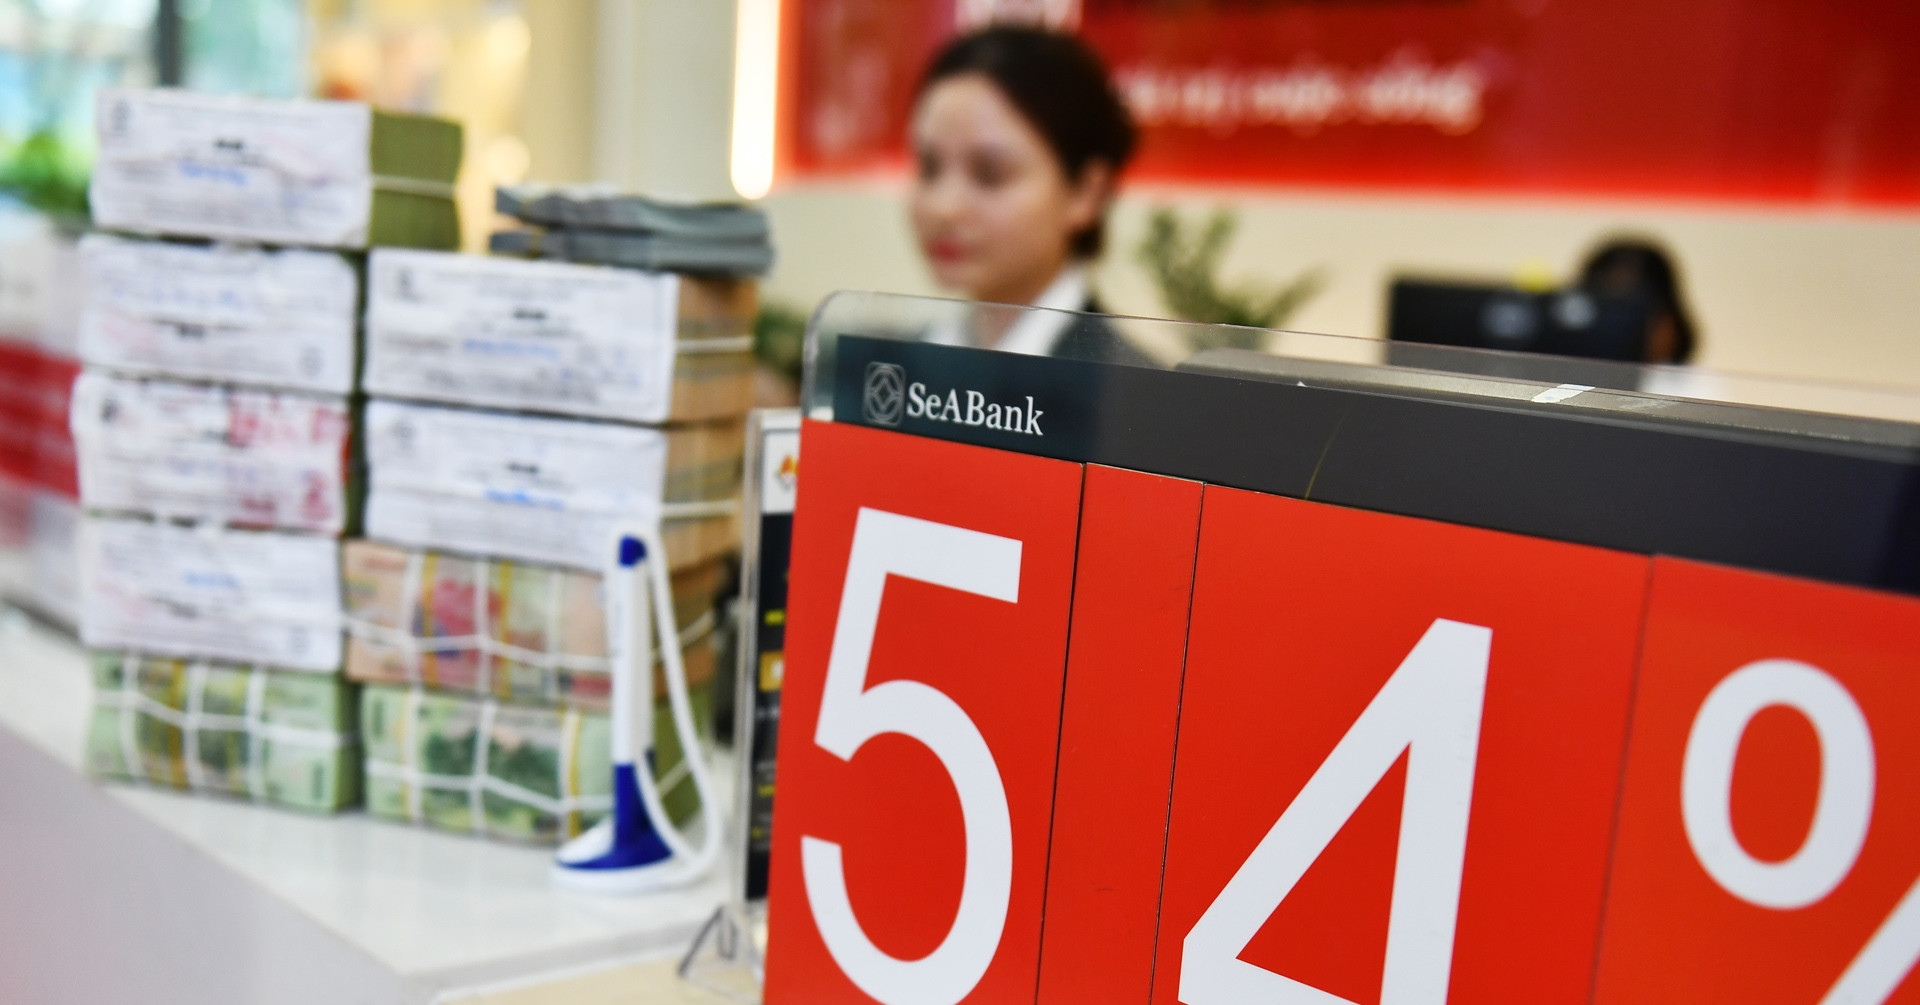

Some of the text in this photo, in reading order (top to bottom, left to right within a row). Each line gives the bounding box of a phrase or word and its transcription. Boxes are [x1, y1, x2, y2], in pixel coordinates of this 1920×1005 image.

[906, 381, 1045, 437] SeABank
[801, 506, 1023, 1005] 5
[1177, 618, 1493, 1005] 4
